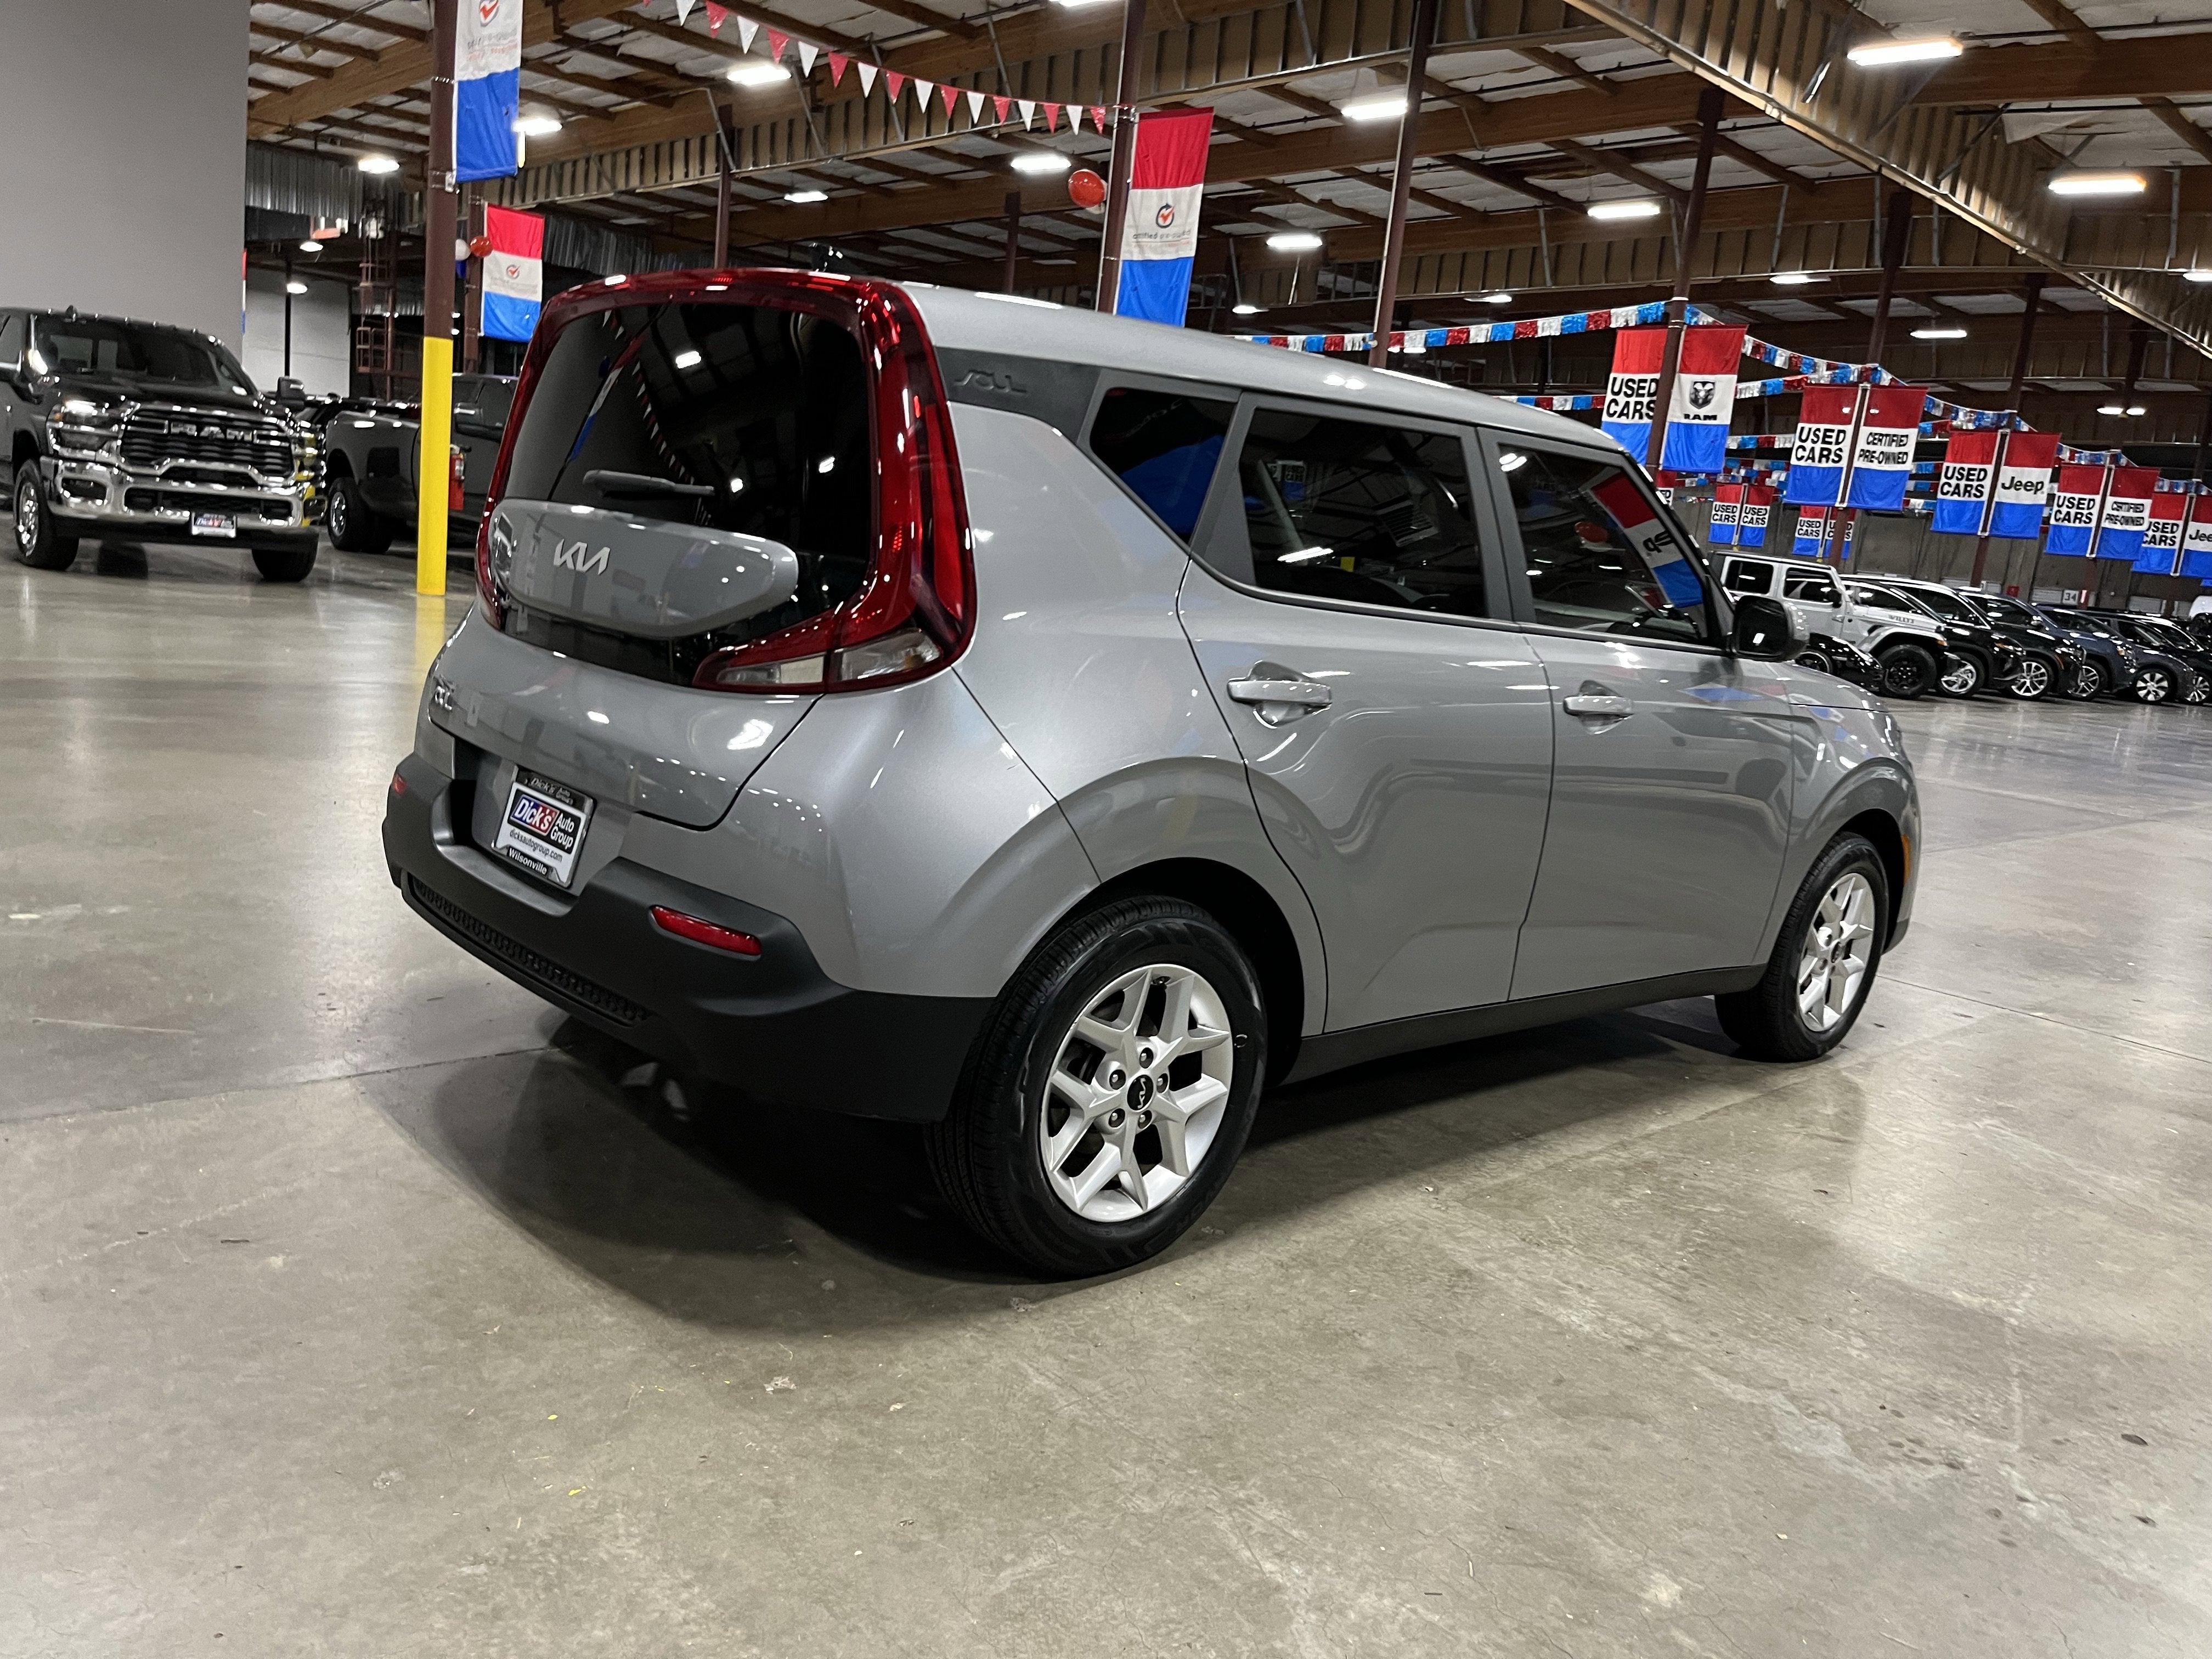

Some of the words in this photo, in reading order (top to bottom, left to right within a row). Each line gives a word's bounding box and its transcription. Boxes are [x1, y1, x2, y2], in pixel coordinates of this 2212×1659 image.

[1611, 377, 1658, 398] USED
[1606, 398, 1656, 420] CARS
[1798, 426, 1846, 445] USED
[1866, 432, 1909, 447] CERTIFIED
[1795, 445, 1843, 464] CARS
[1858, 449, 1908, 465] PRE-OWNED
[1944, 466, 1988, 482] USED
[1940, 482, 1984, 498] CARS
[2001, 476, 2044, 494] Jeep
[1714, 504, 1738, 514] USED
[2057, 495, 2095, 510] USED
[1712, 514, 1736, 523] CARS
[1744, 506, 1768, 516] USED
[2054, 510, 2093, 524] CARS
[1742, 516, 1766, 526] CARS
[1799, 519, 1821, 528] USED
[1830, 521, 1853, 531] UD
[1797, 528, 1820, 537] CARS
[1827, 531, 1851, 539] CS
[2189, 529, 2212, 542] Jee
[554, 538, 610, 575] KIA
[2064, 592, 2077, 601] 34
[514, 798, 552, 831] Dick's
[555, 812, 574, 833] Auto
[509, 828, 563, 862] dicksautogroup.com
[550, 826, 574, 850] Group
[509, 848, 548, 875] Wilsonville
